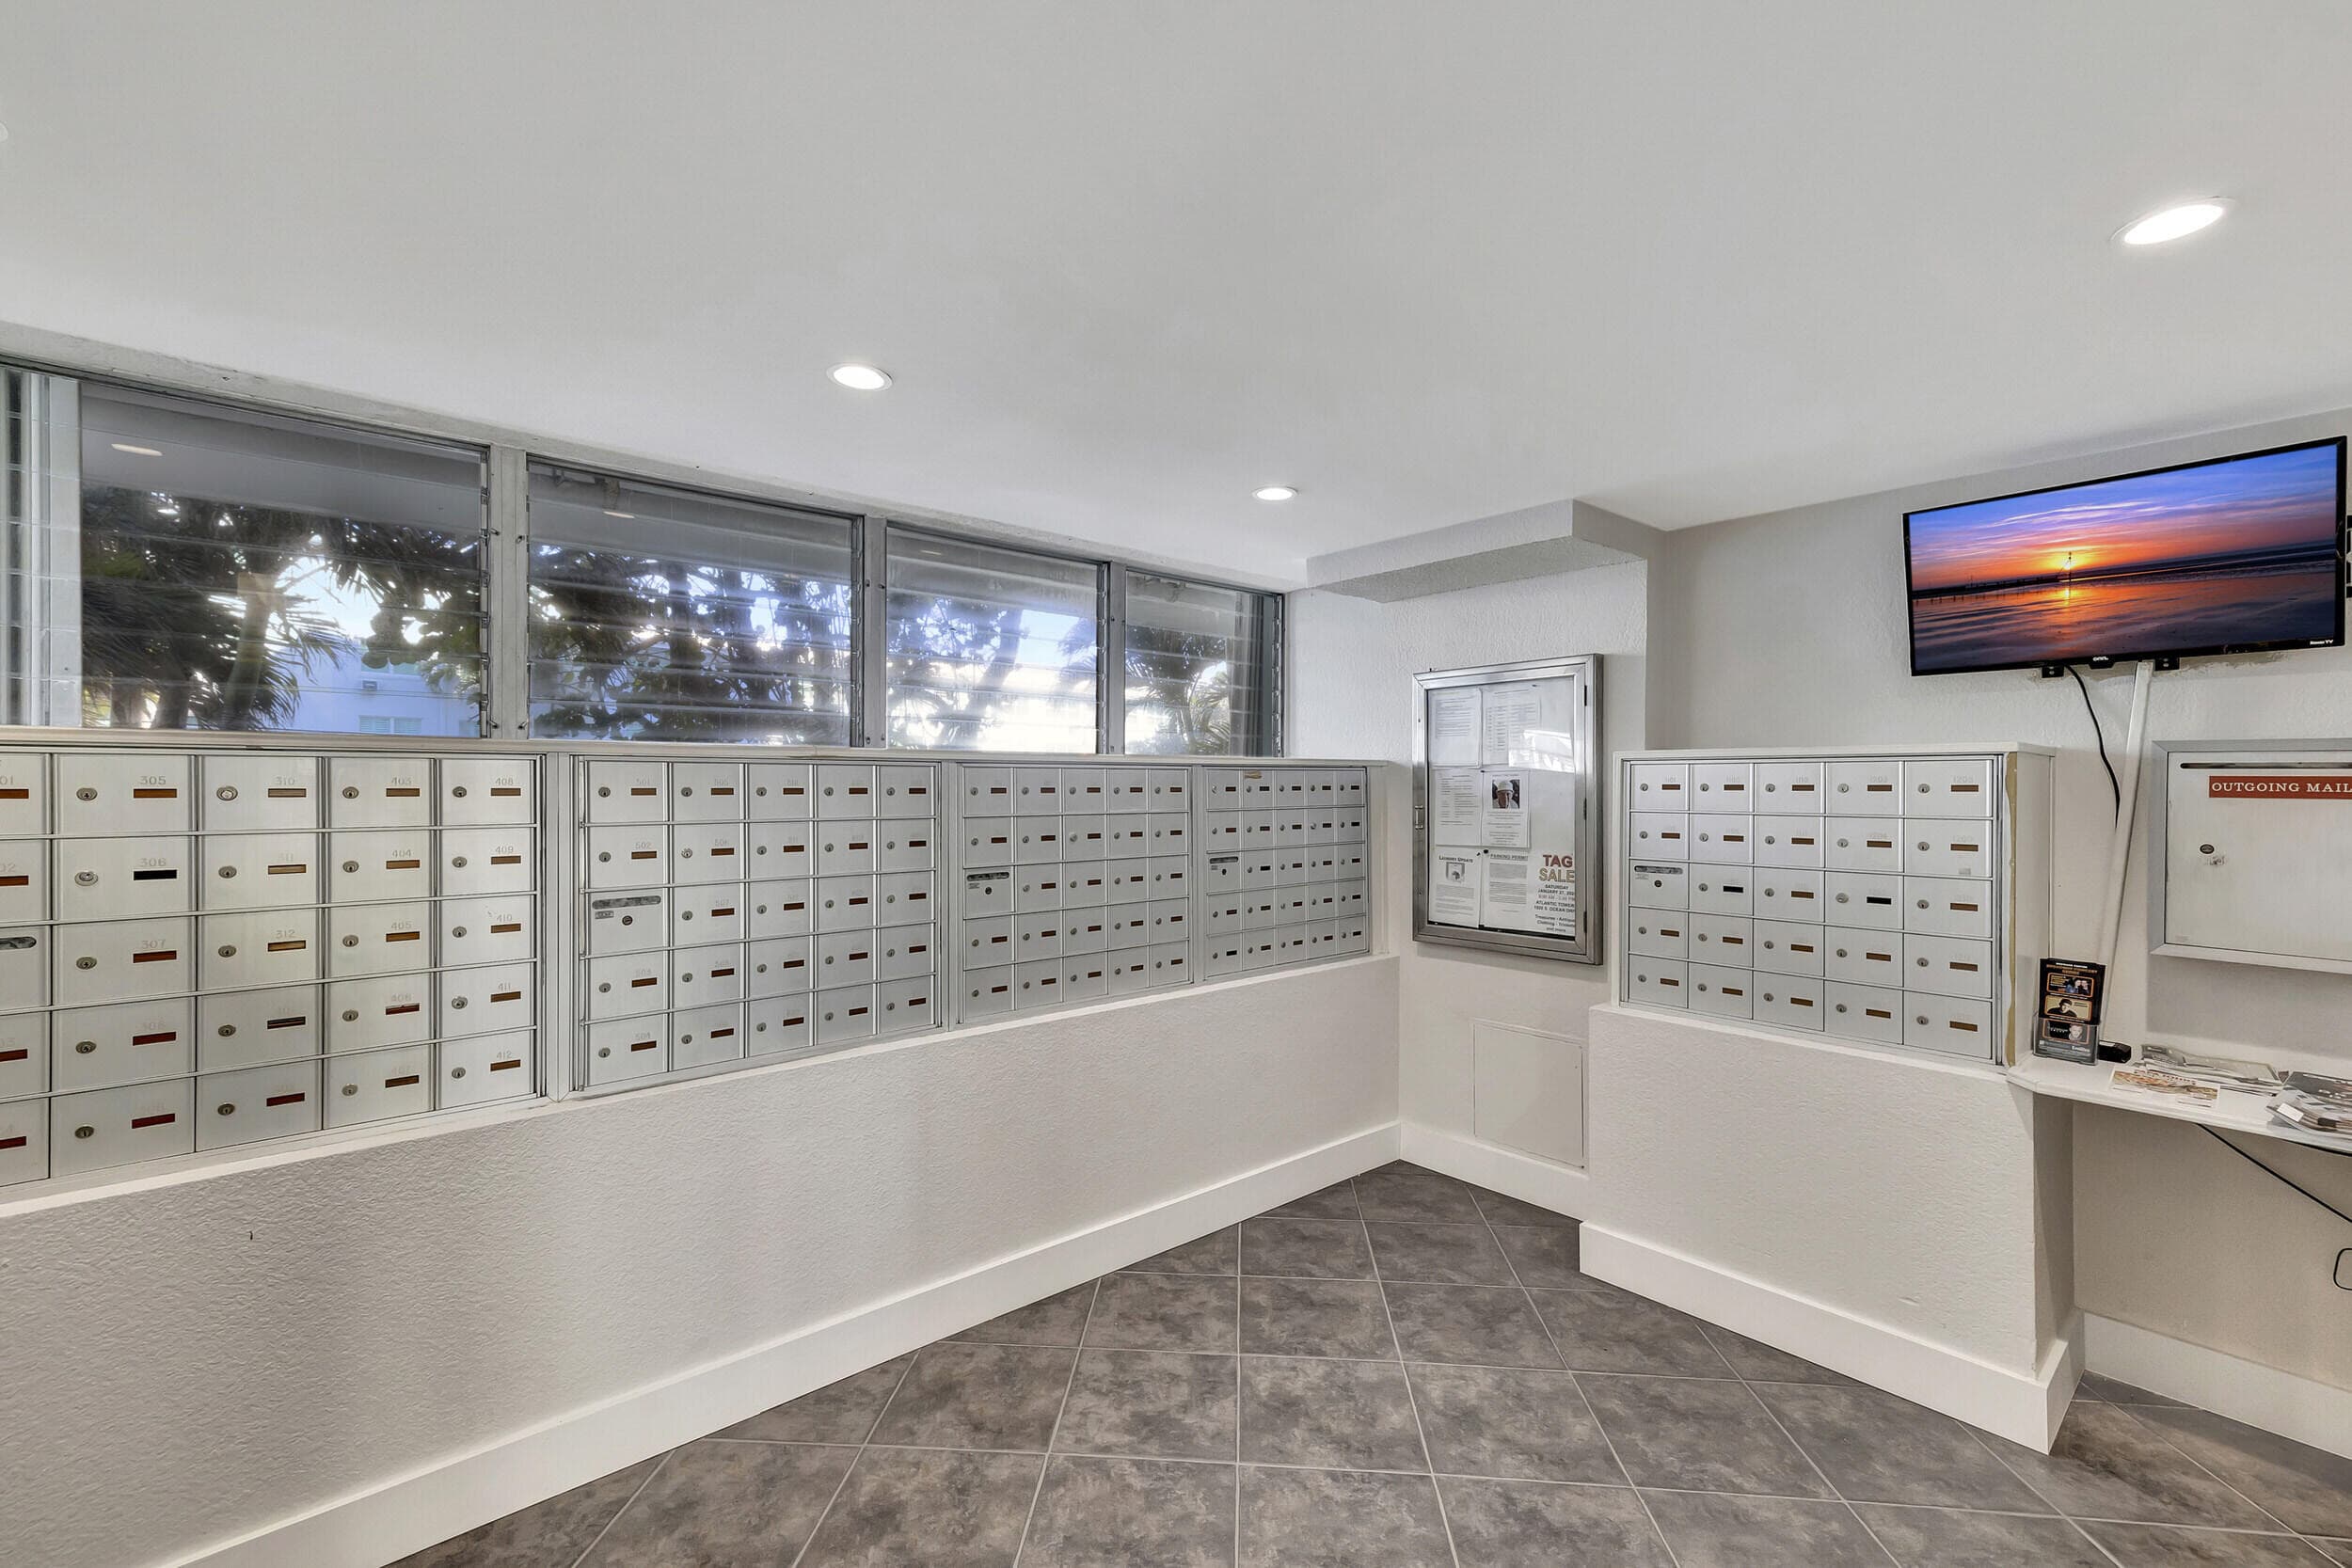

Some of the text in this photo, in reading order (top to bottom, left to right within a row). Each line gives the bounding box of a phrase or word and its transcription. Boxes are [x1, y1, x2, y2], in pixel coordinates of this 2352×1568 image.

[140, 775, 167, 785] 305
[275, 776, 296, 785] 310
[495, 778, 514, 786] 408
[2212, 783, 2352, 793] OUTGOING MAIL
[391, 848, 412, 858] 404
[495, 846, 514, 854] 409
[140, 858, 167, 867] 306
[1543, 854, 1573, 867] TAG
[1538, 868, 1575, 883] SALE
[497, 913, 513, 922] 410
[391, 921, 412, 929] 405
[275, 929, 296, 939] 312
[141, 939, 167, 950] 307
[498, 982, 511, 991] 411
[497, 1051, 513, 1059] 412
